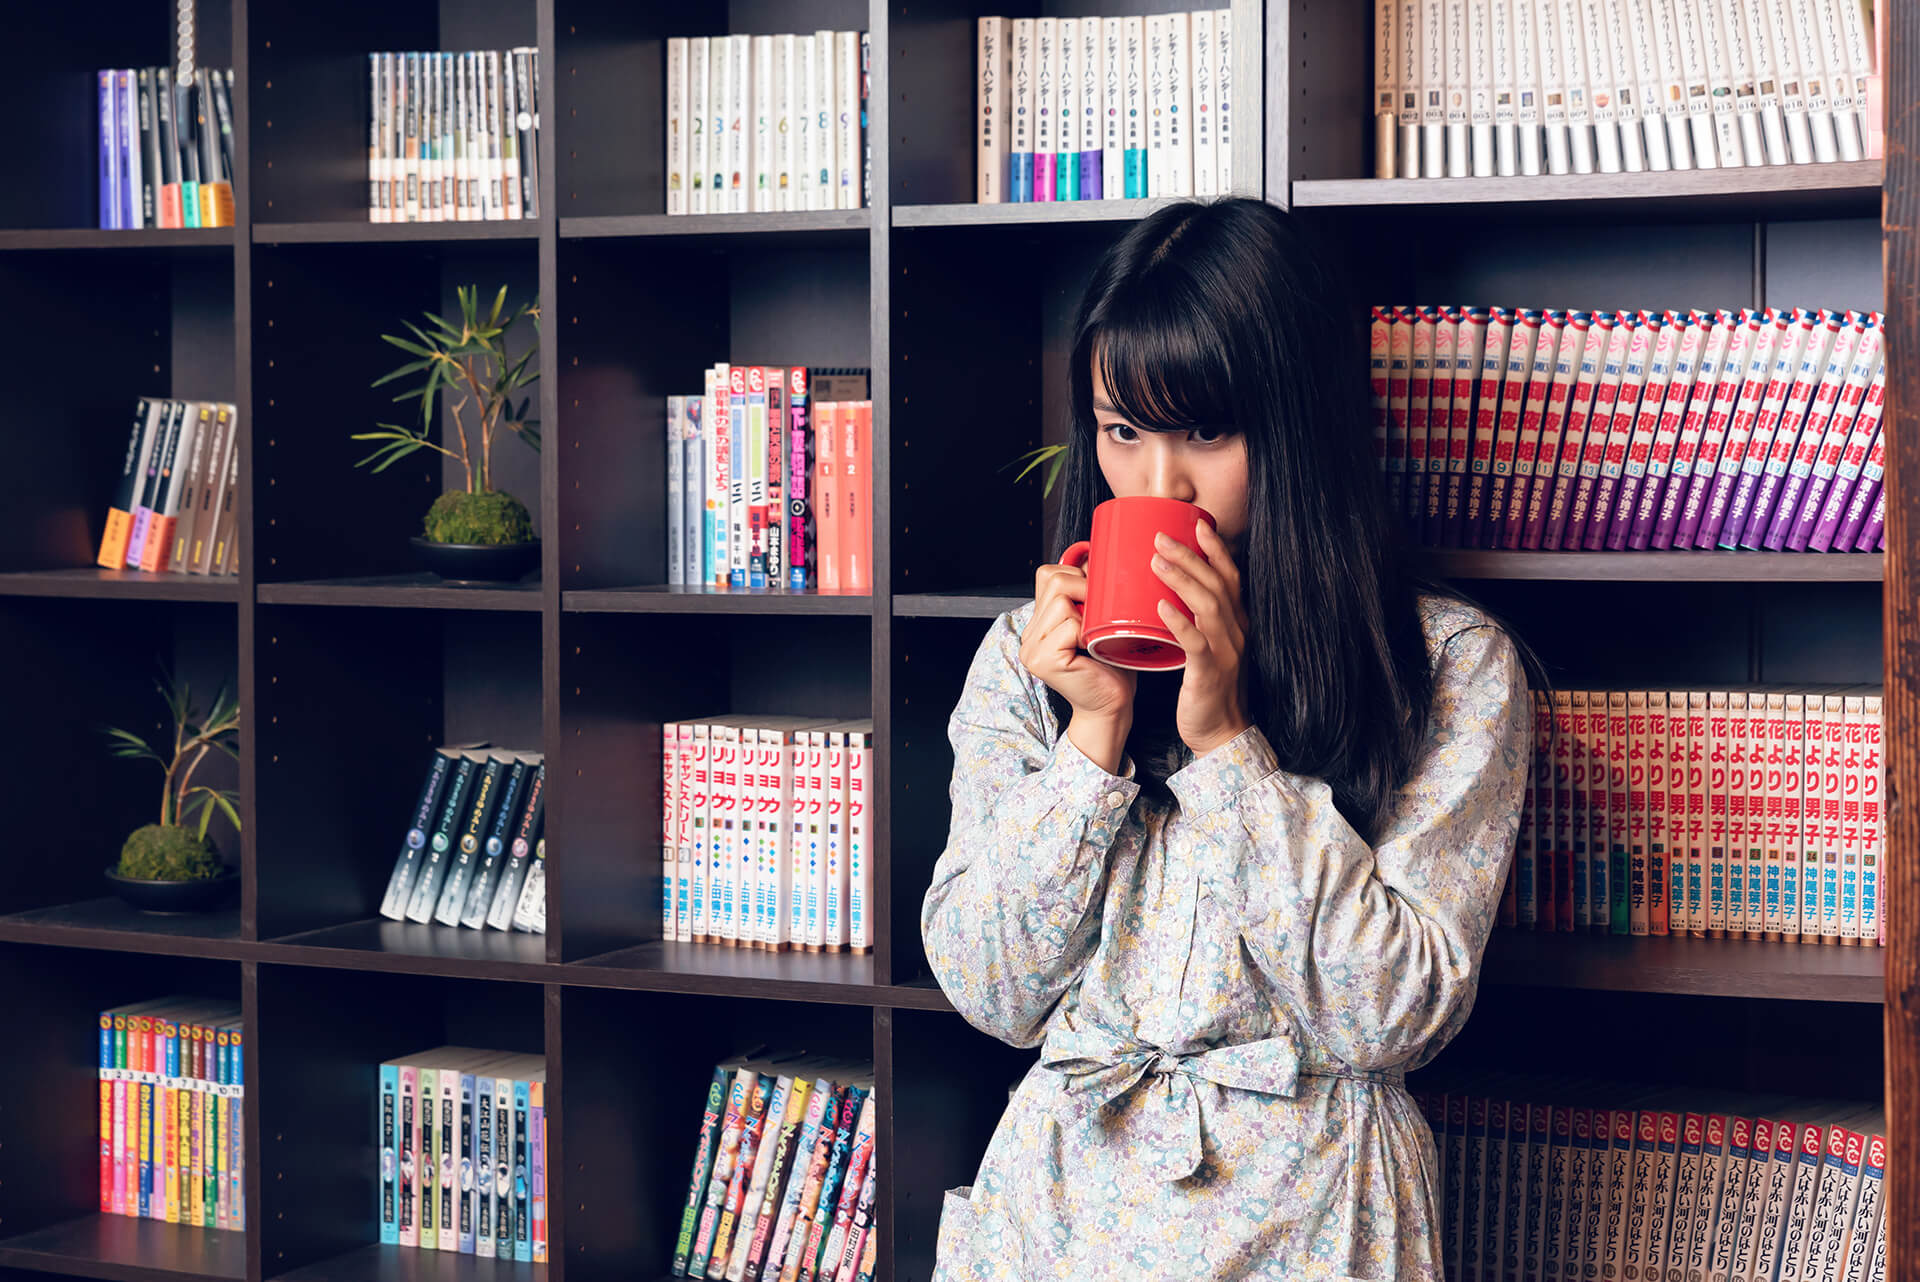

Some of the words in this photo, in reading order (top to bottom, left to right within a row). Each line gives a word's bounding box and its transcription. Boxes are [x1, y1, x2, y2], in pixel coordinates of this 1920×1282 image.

[672, 118, 678, 134] 1
[694, 118, 702, 134] 2
[714, 118, 724, 134] 3
[732, 117, 741, 132] 4
[759, 117, 768, 133] 5
[779, 117, 788, 134] 6
[800, 117, 808, 133] 7
[819, 112, 828, 128] 8
[823, 466, 829, 474] 1
[848, 465, 856, 475] 2
[663, 752, 673, 844] キャットストリート
[679, 753, 691, 844] キャットストリート
[694, 746, 707, 808] リョウ
[711, 747, 726, 809] リョウ
[724, 748, 736, 810] リョウ
[742, 749, 754, 812] リョウ
[758, 750, 770, 812] リョウ
[769, 751, 781, 813] リョウ
[792, 752, 806, 814] リョウ
[808, 752, 821, 815] リョウ
[828, 752, 841, 815] リョウ
[849, 753, 863, 816] リョウ
[1610, 716, 1626, 839] 花より男子
[1629, 714, 1646, 838] 花より男子
[1649, 714, 1666, 838] 花より男子
[1669, 717, 1686, 840] 花より男子
[1689, 717, 1704, 841] 花より男子
[1710, 717, 1727, 842] 花より男子
[1730, 718, 1747, 843] 花より男子
[1748, 718, 1766, 843] 花より男子
[1767, 719, 1784, 844] 花より男子
[1784, 720, 1802, 845] 花より男子
[1804, 720, 1823, 845] 花より男子
[1823, 722, 1842, 847] 花より男子
[1842, 722, 1861, 849] 花より男子
[1862, 722, 1880, 849] 花より男子
[408, 850, 414, 859] 1
[432, 852, 439, 862] 2
[460, 854, 468, 864] 3
[1671, 862, 1684, 914] 神尾葉子
[1711, 864, 1724, 916] 神尾葉子
[1730, 864, 1743, 917] 神尾葉子
[1748, 864, 1761, 918] 神尾葉子
[1766, 864, 1780, 918] 神尾葉子
[1784, 867, 1797, 920] 神尾葉子
[1804, 867, 1817, 920] 神尾葉子
[1842, 870, 1856, 924] 神尾葉子
[1862, 870, 1876, 924] 神尾葉子
[690, 1191, 696, 1206] 1
[709, 1194, 717, 1206] 2
[726, 1196, 736, 1209] 3
[816, 1208, 824, 1221] 8
[1605, 1151, 1629, 1262] 天は赤い河のほとり
[1624, 1152, 1652, 1264] 天は赤い河のほとり
[1648, 1156, 1672, 1266] 天は赤い河のほとり
[1670, 1156, 1696, 1267] 天は赤い河のほとり
[1691, 1157, 1717, 1268] 天は赤い河のほとり
[1716, 1160, 1743, 1270] 天は赤い河のほとり
[1735, 1163, 1764, 1273] 天は赤い河のほとり
[1758, 1164, 1786, 1274] 天は赤い河のほとり
[1784, 1167, 1814, 1278] 天は赤い河のほとり
[1806, 1168, 1837, 1279] 天は赤い河のほとり
